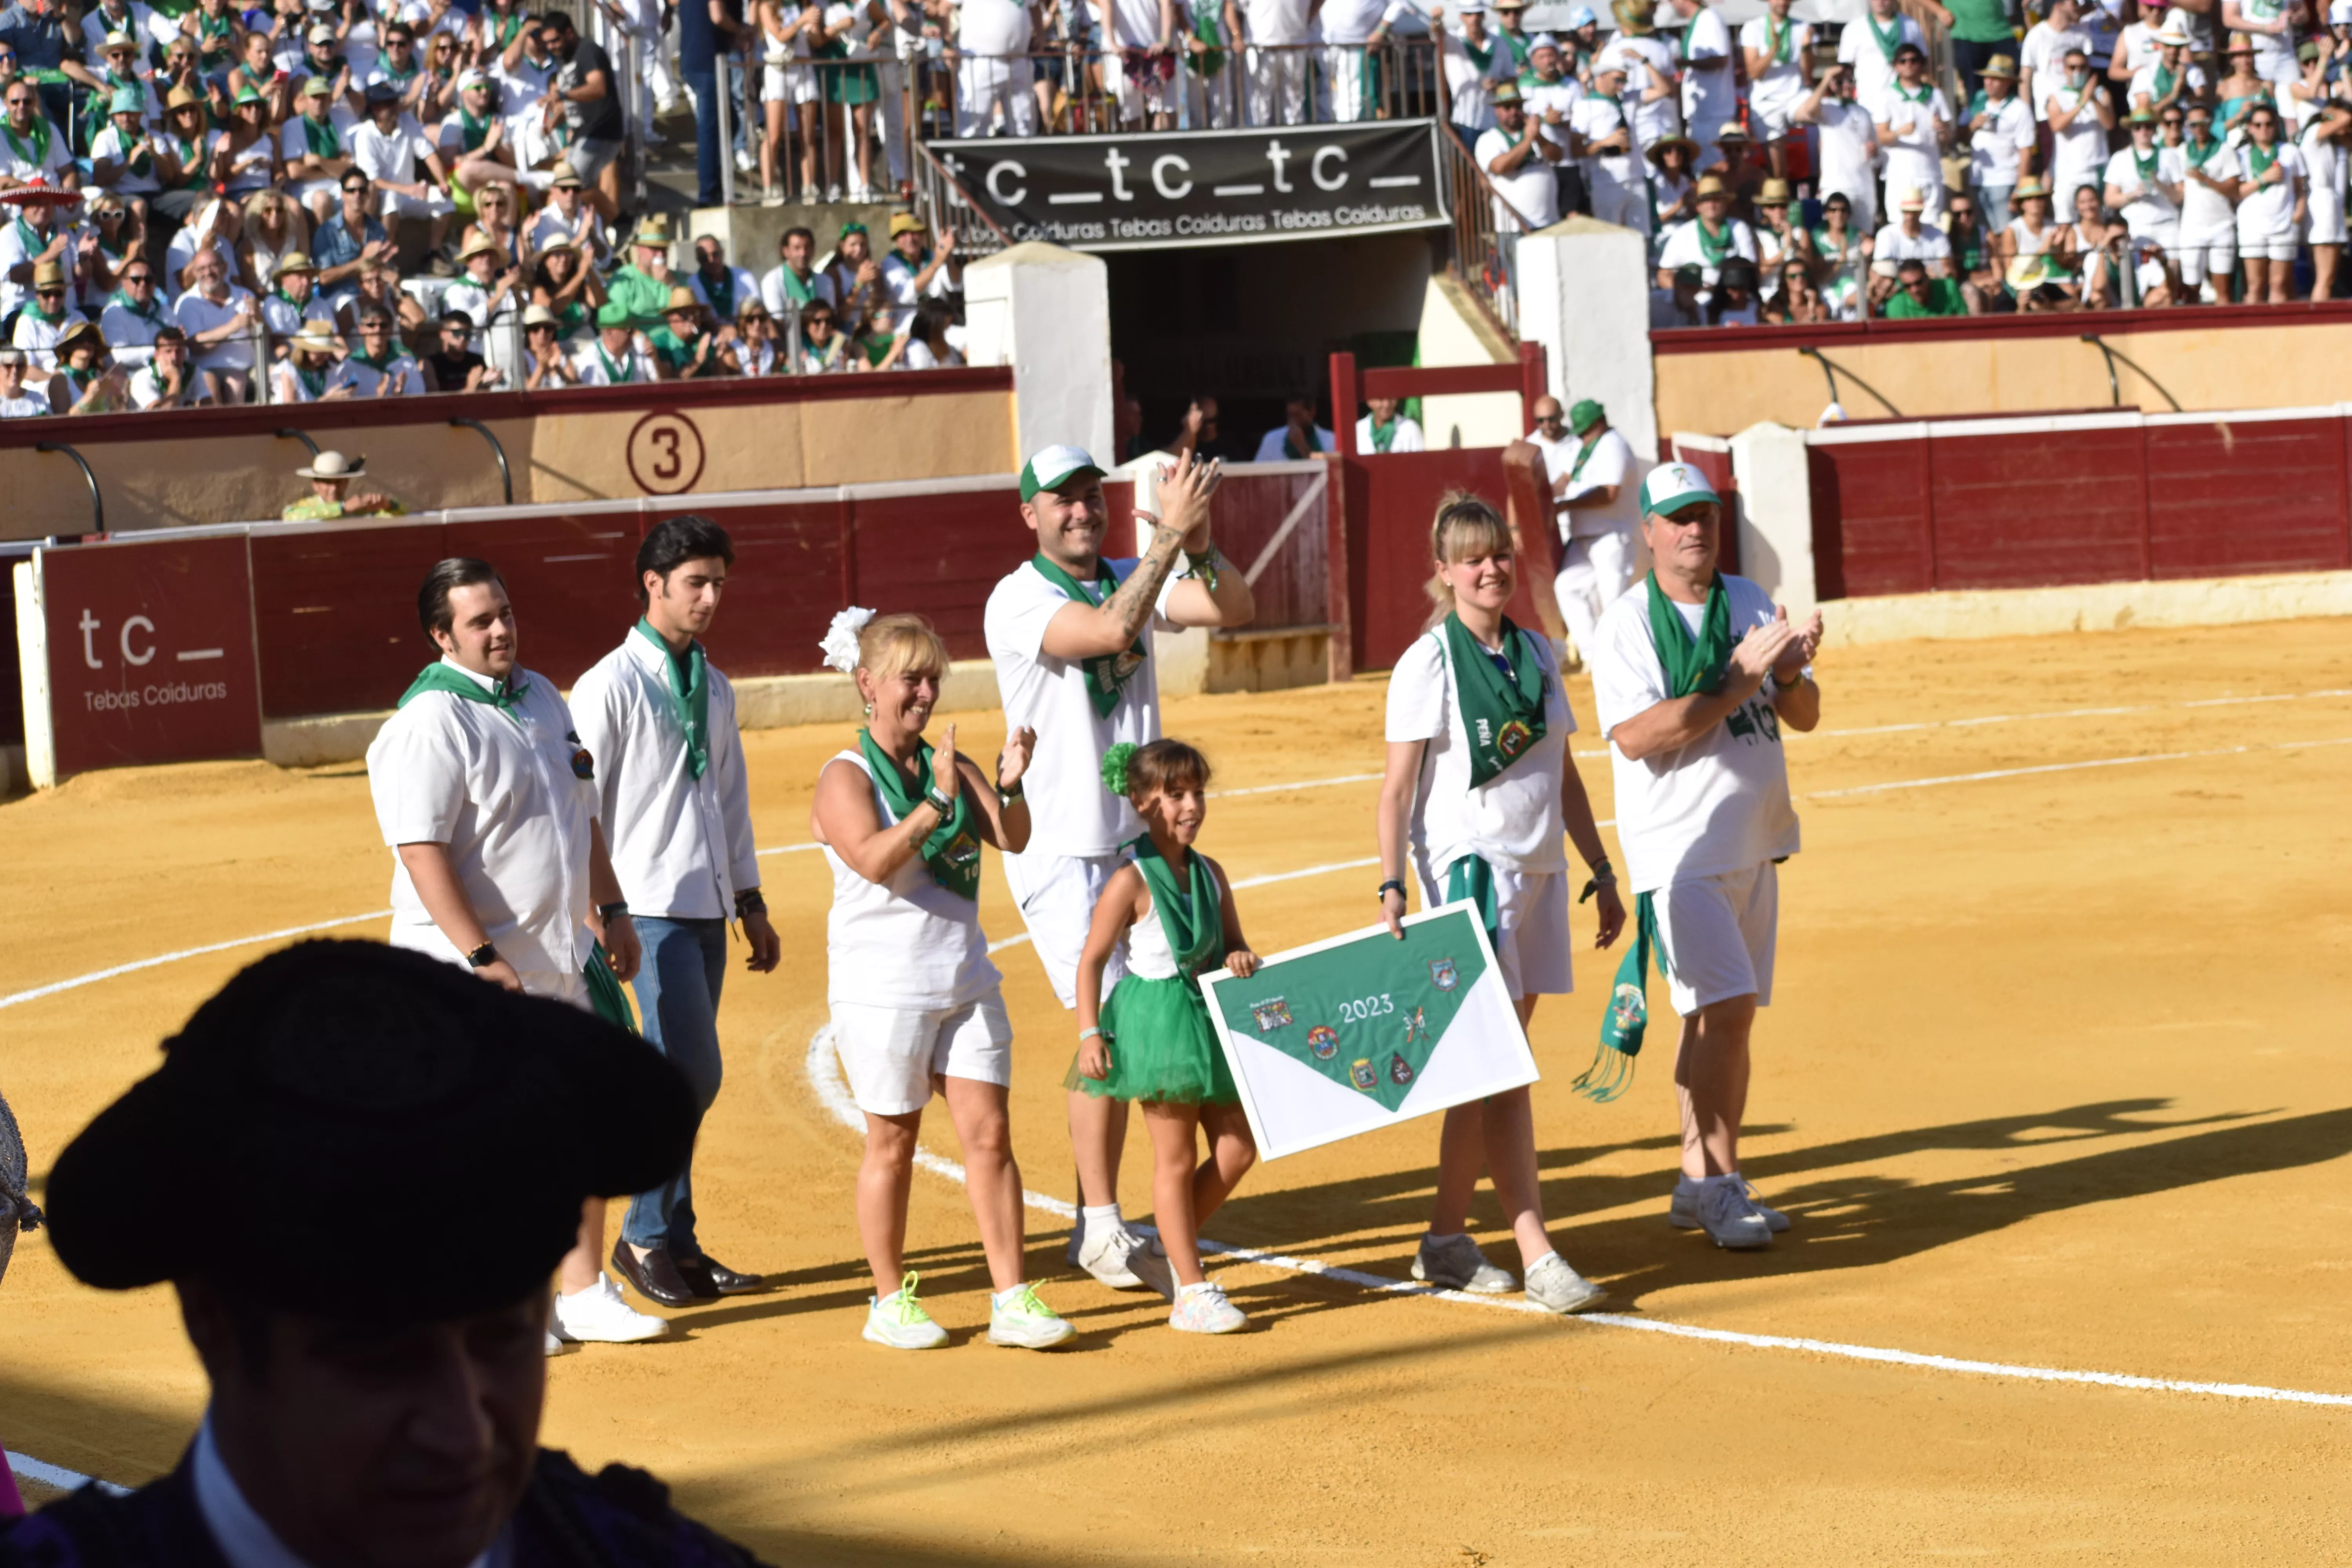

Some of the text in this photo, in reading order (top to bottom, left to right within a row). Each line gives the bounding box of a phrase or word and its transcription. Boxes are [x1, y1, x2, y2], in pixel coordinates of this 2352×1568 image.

[1013, 220, 1104, 241] Coiduras
[1109, 217, 1172, 238] Tebas
[1176, 212, 1266, 234] Coiduras
[1270, 208, 1332, 230] Tebas
[1334, 203, 1425, 225] Coiduras
[652, 427, 681, 479] 3
[83, 682, 227, 712] Tebas Coiduras
[1339, 993, 1394, 1024] 2023
